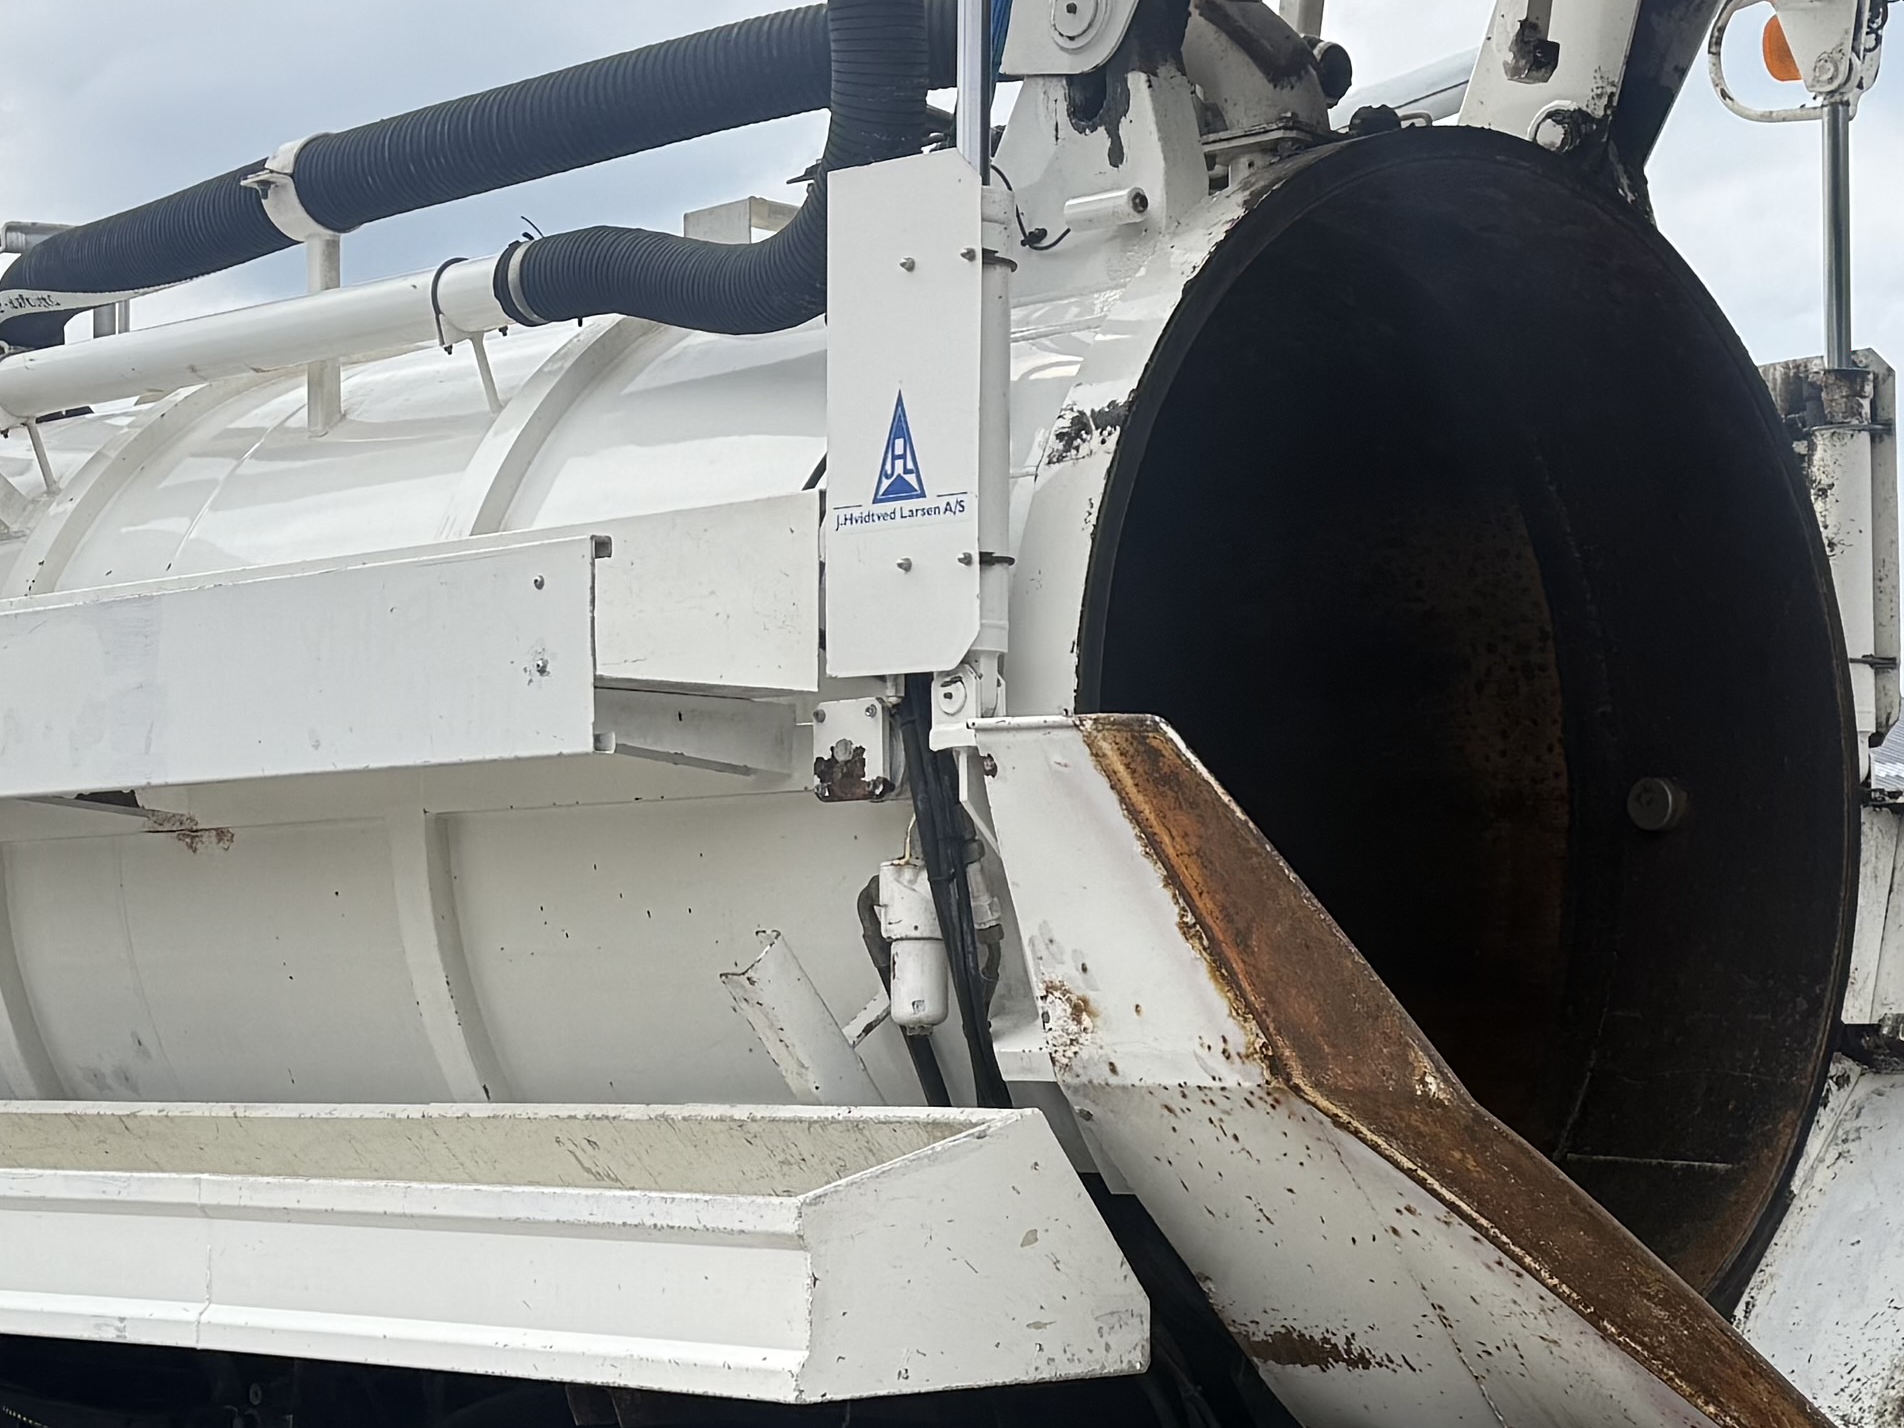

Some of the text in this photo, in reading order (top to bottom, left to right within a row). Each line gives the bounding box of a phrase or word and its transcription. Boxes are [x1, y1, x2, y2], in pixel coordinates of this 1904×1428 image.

[835, 499, 965, 531] J.Hvidtved Larsen A/S
